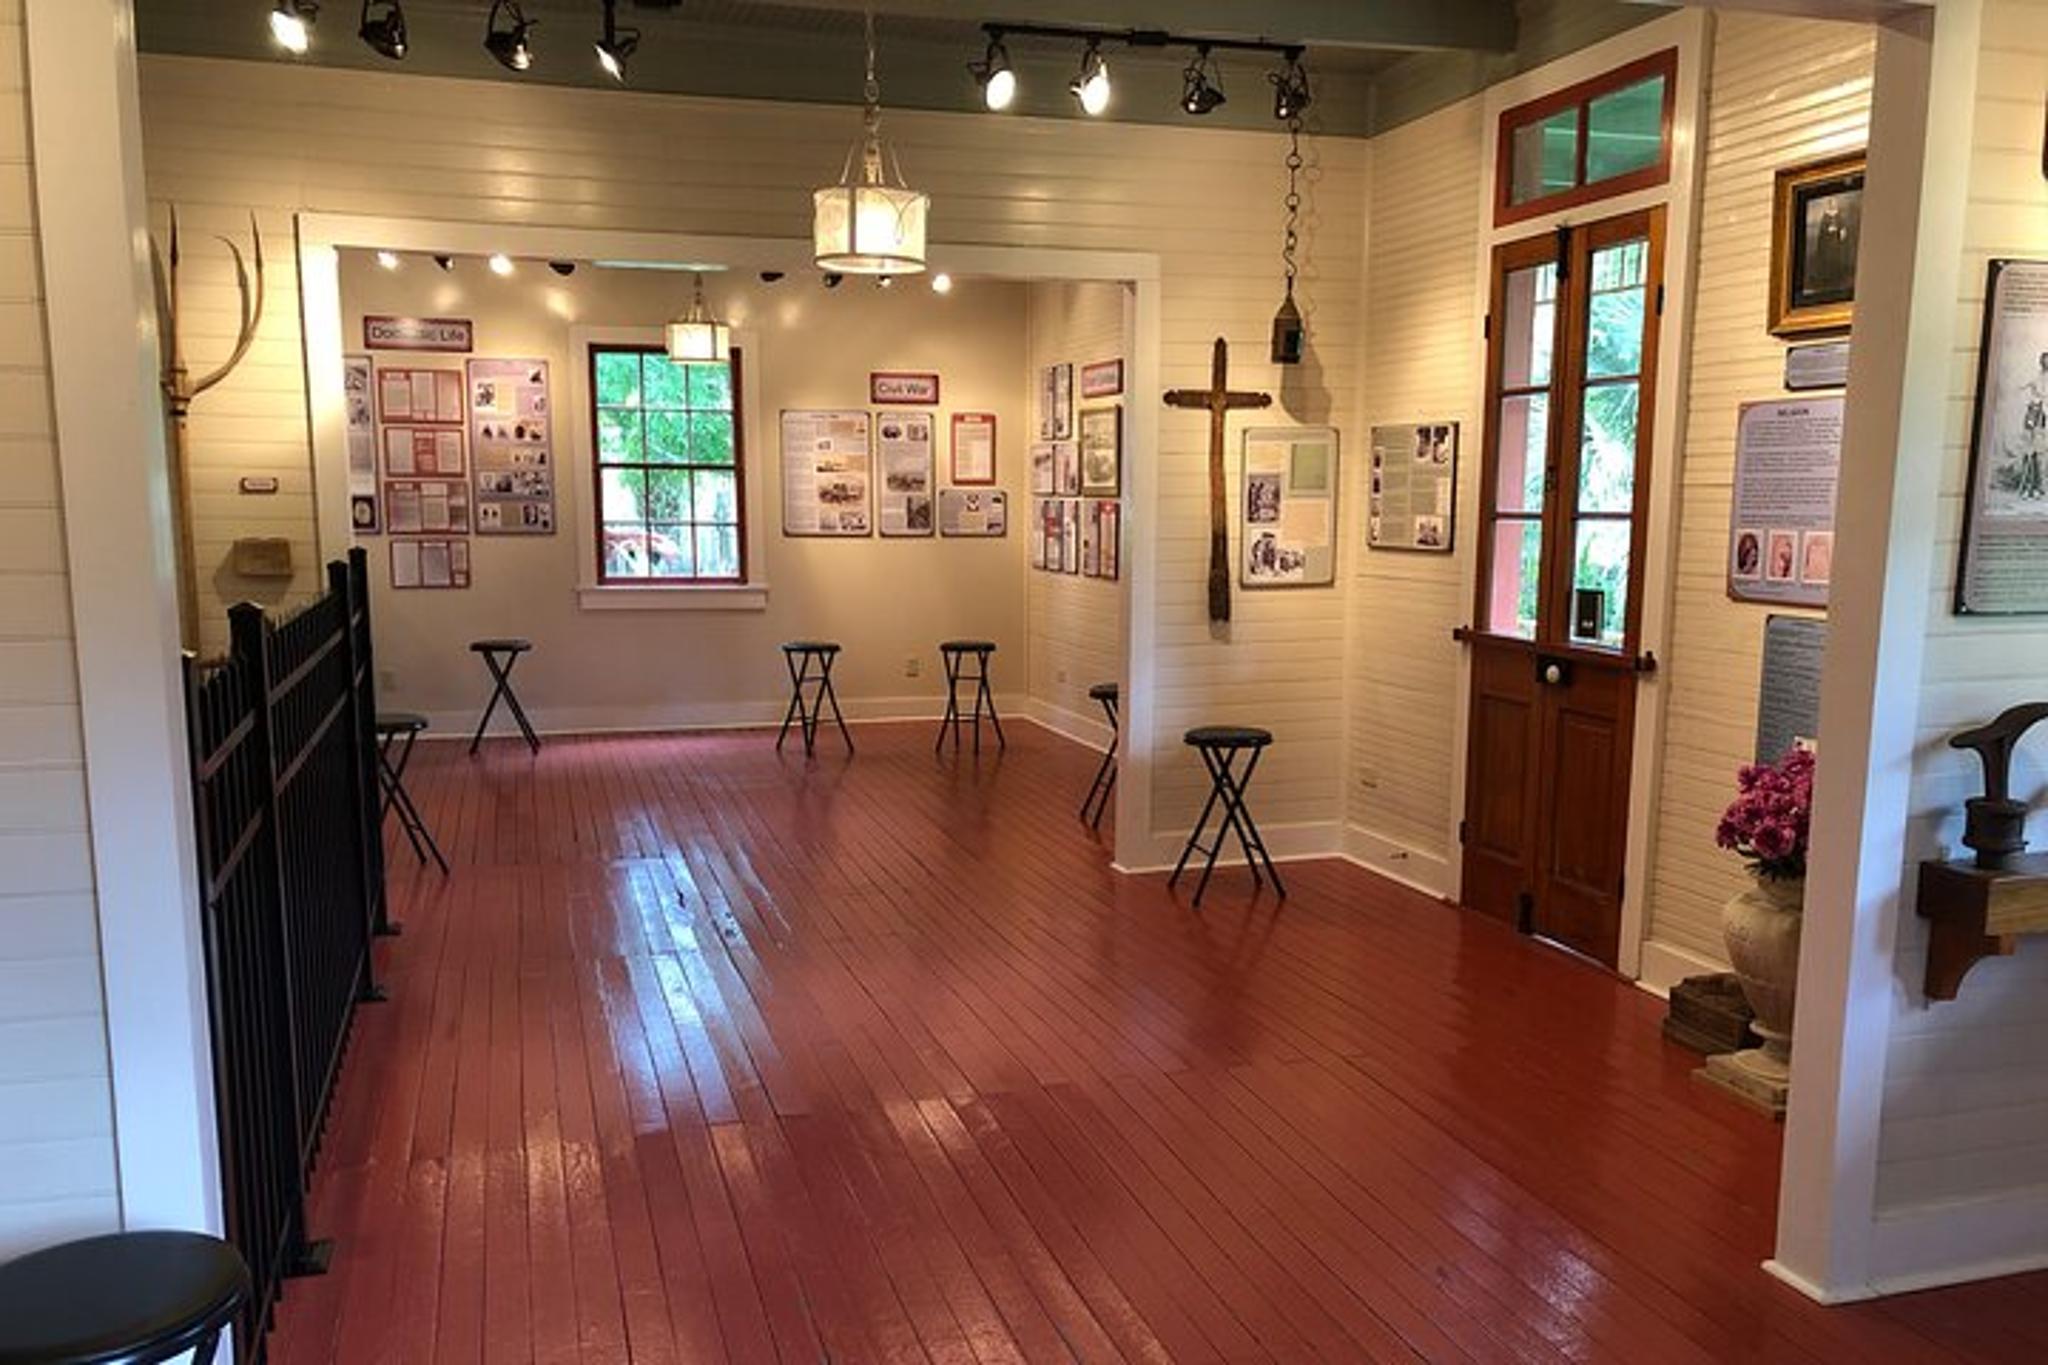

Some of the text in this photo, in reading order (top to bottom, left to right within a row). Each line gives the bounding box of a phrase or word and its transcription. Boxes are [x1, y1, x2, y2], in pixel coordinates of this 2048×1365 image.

[440, 328, 465, 342] Life
[878, 382, 931, 396] Civil War
